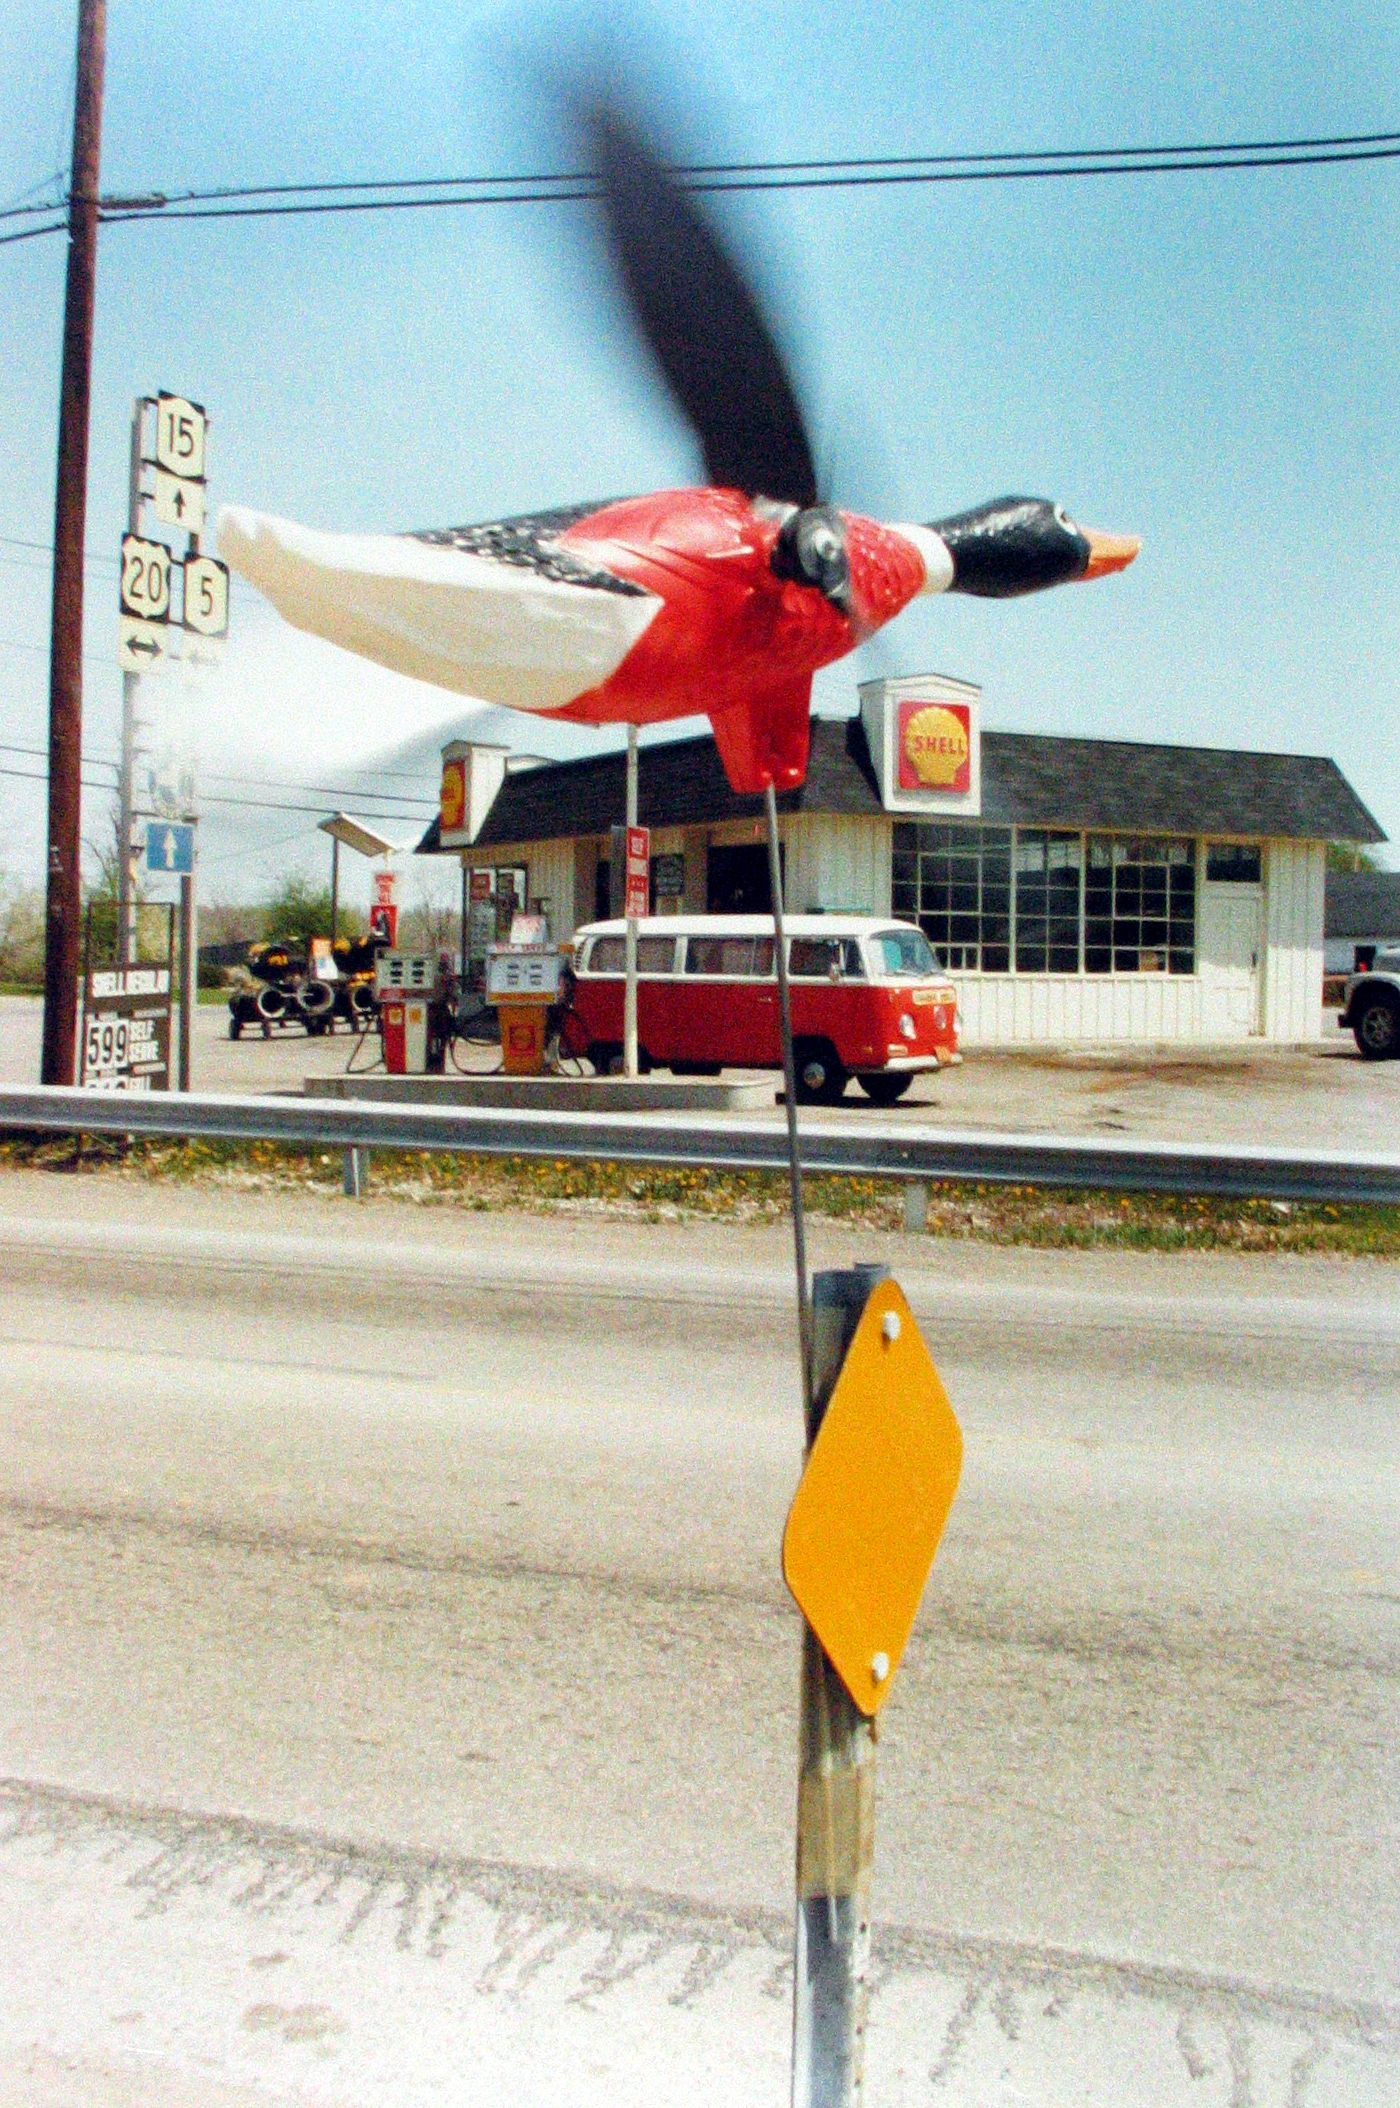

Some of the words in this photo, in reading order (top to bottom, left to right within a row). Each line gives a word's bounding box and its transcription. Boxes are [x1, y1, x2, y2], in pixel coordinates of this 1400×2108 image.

[169, 413, 194, 458] 15
[129, 555, 162, 603] 20
[201, 575, 213, 617] 5
[913, 735, 965, 757] SHELL
